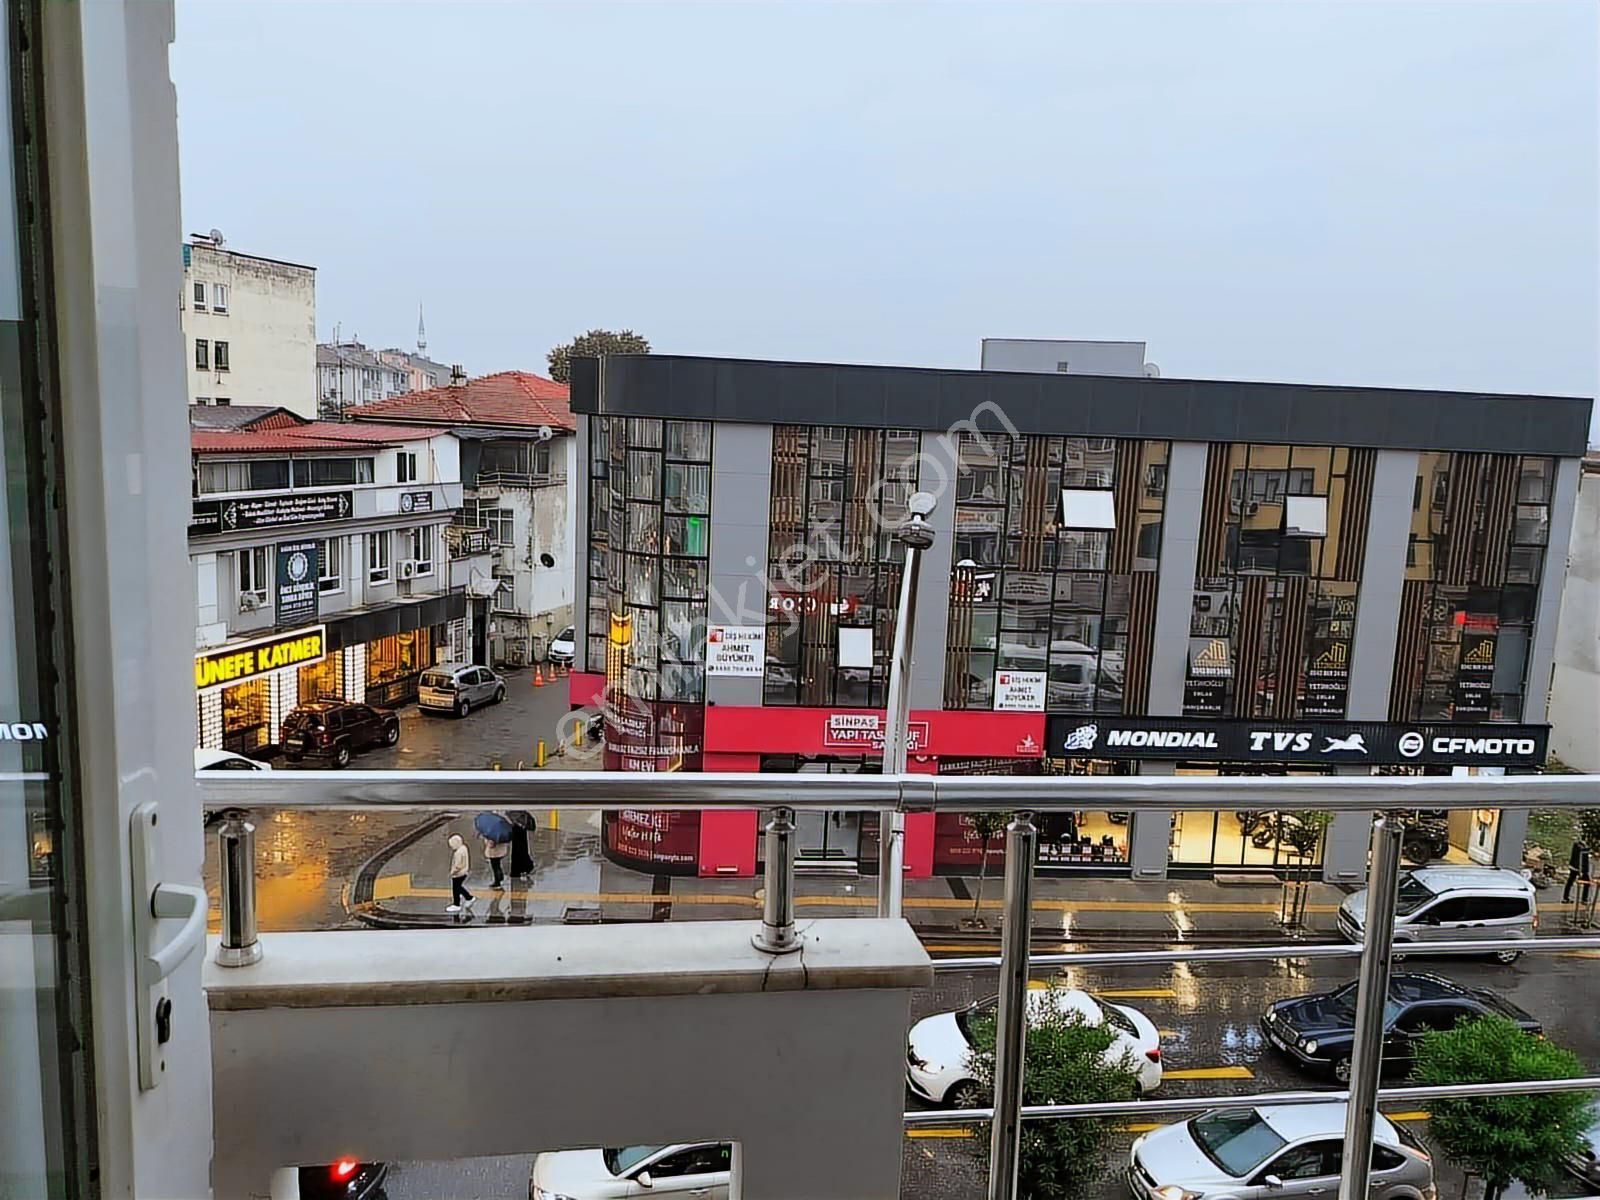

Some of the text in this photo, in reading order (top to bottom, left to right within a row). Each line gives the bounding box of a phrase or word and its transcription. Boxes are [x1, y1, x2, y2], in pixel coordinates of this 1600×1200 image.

[258, 635, 321, 671] KATMER
[834, 716, 876, 728] SİNPAŞ
[831, 730, 859, 740] YAPI
[1106, 730, 1218, 748] MONDIAL
[1250, 732, 1312, 751] TVS
[1432, 738, 1535, 755] CFMOTO
